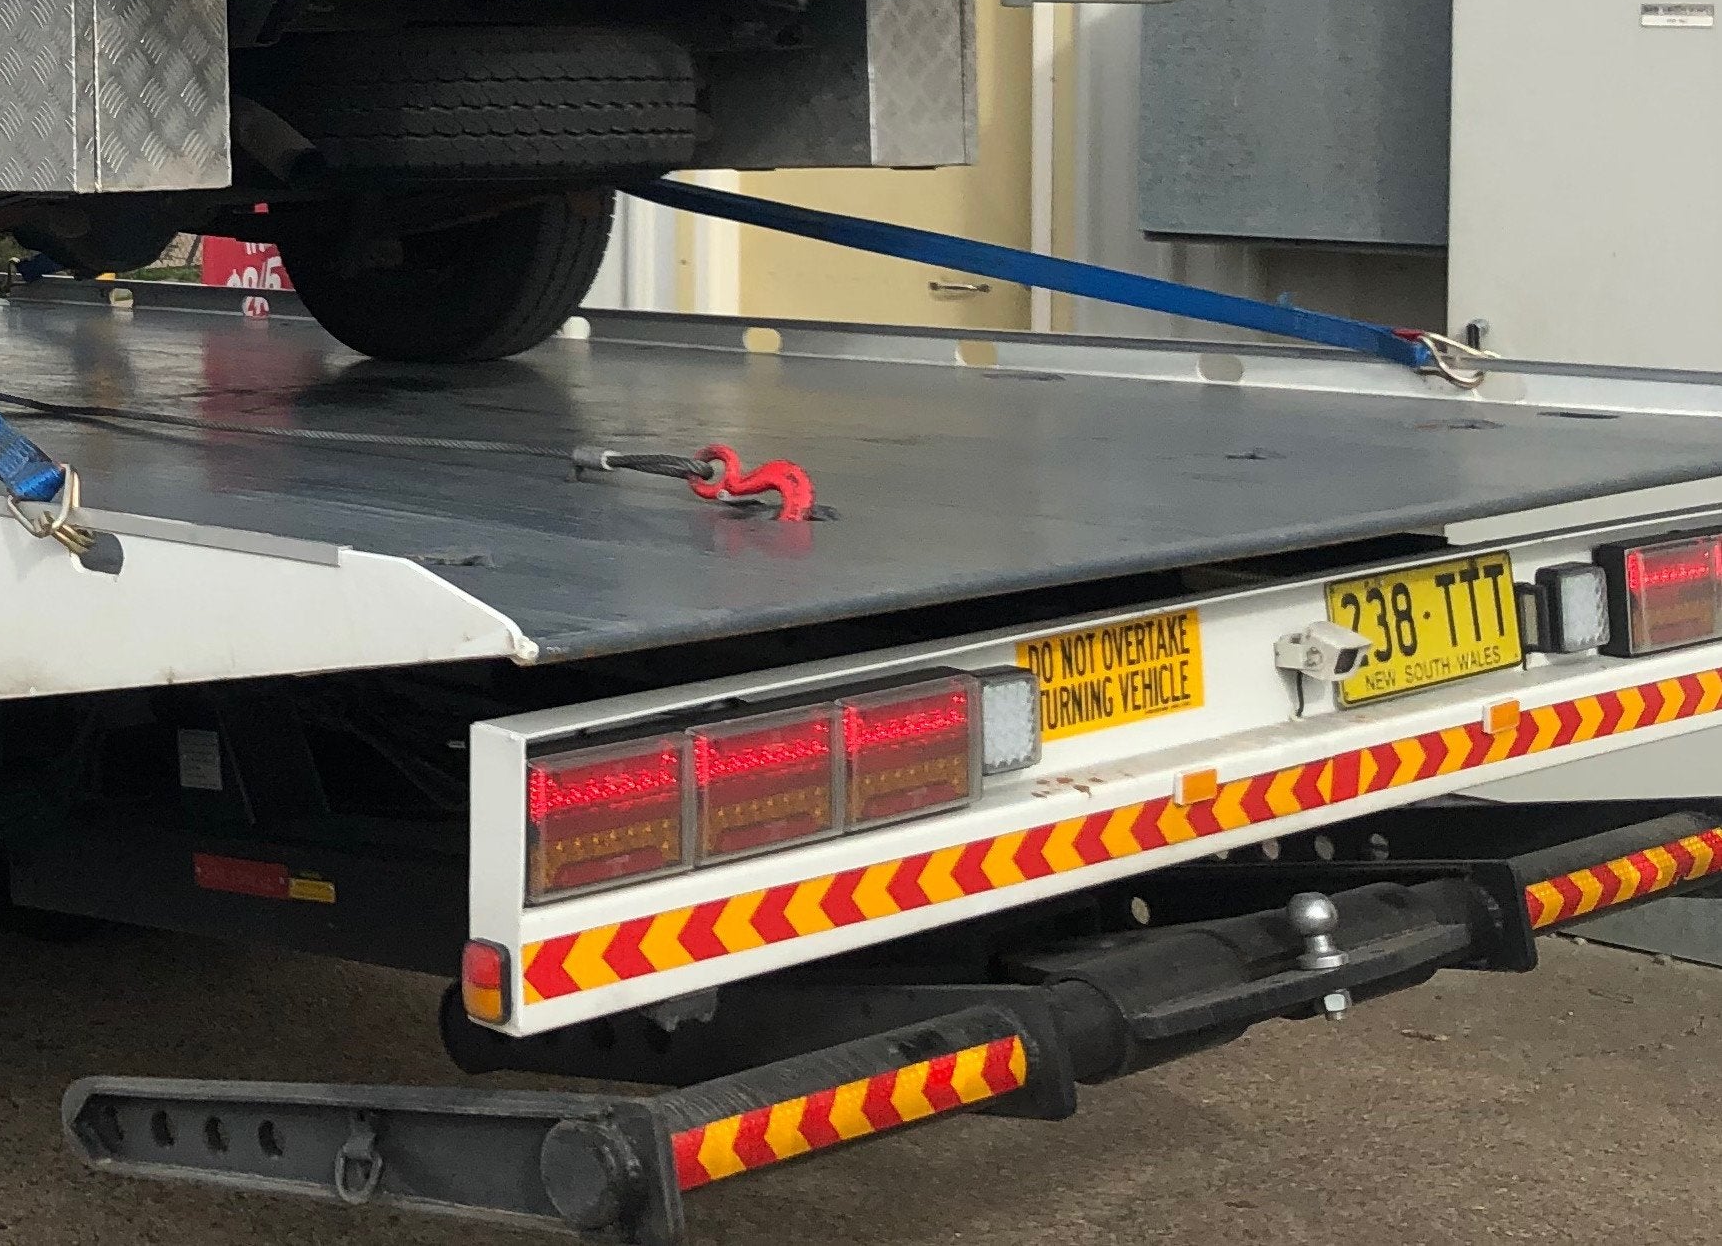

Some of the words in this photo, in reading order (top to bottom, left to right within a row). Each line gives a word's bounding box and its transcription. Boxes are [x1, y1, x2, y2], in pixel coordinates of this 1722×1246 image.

[1028, 640, 1053, 684] DO
[1060, 632, 1096, 680] NOT
[1101, 614, 1190, 672] OVERTAKE
[1365, 670, 1396, 691] NEW
[1404, 657, 1451, 684] SOUTH
[1457, 645, 1501, 671] WALES
[1040, 675, 1114, 732] TURNING
[1118, 659, 1191, 714] VEHICLE
